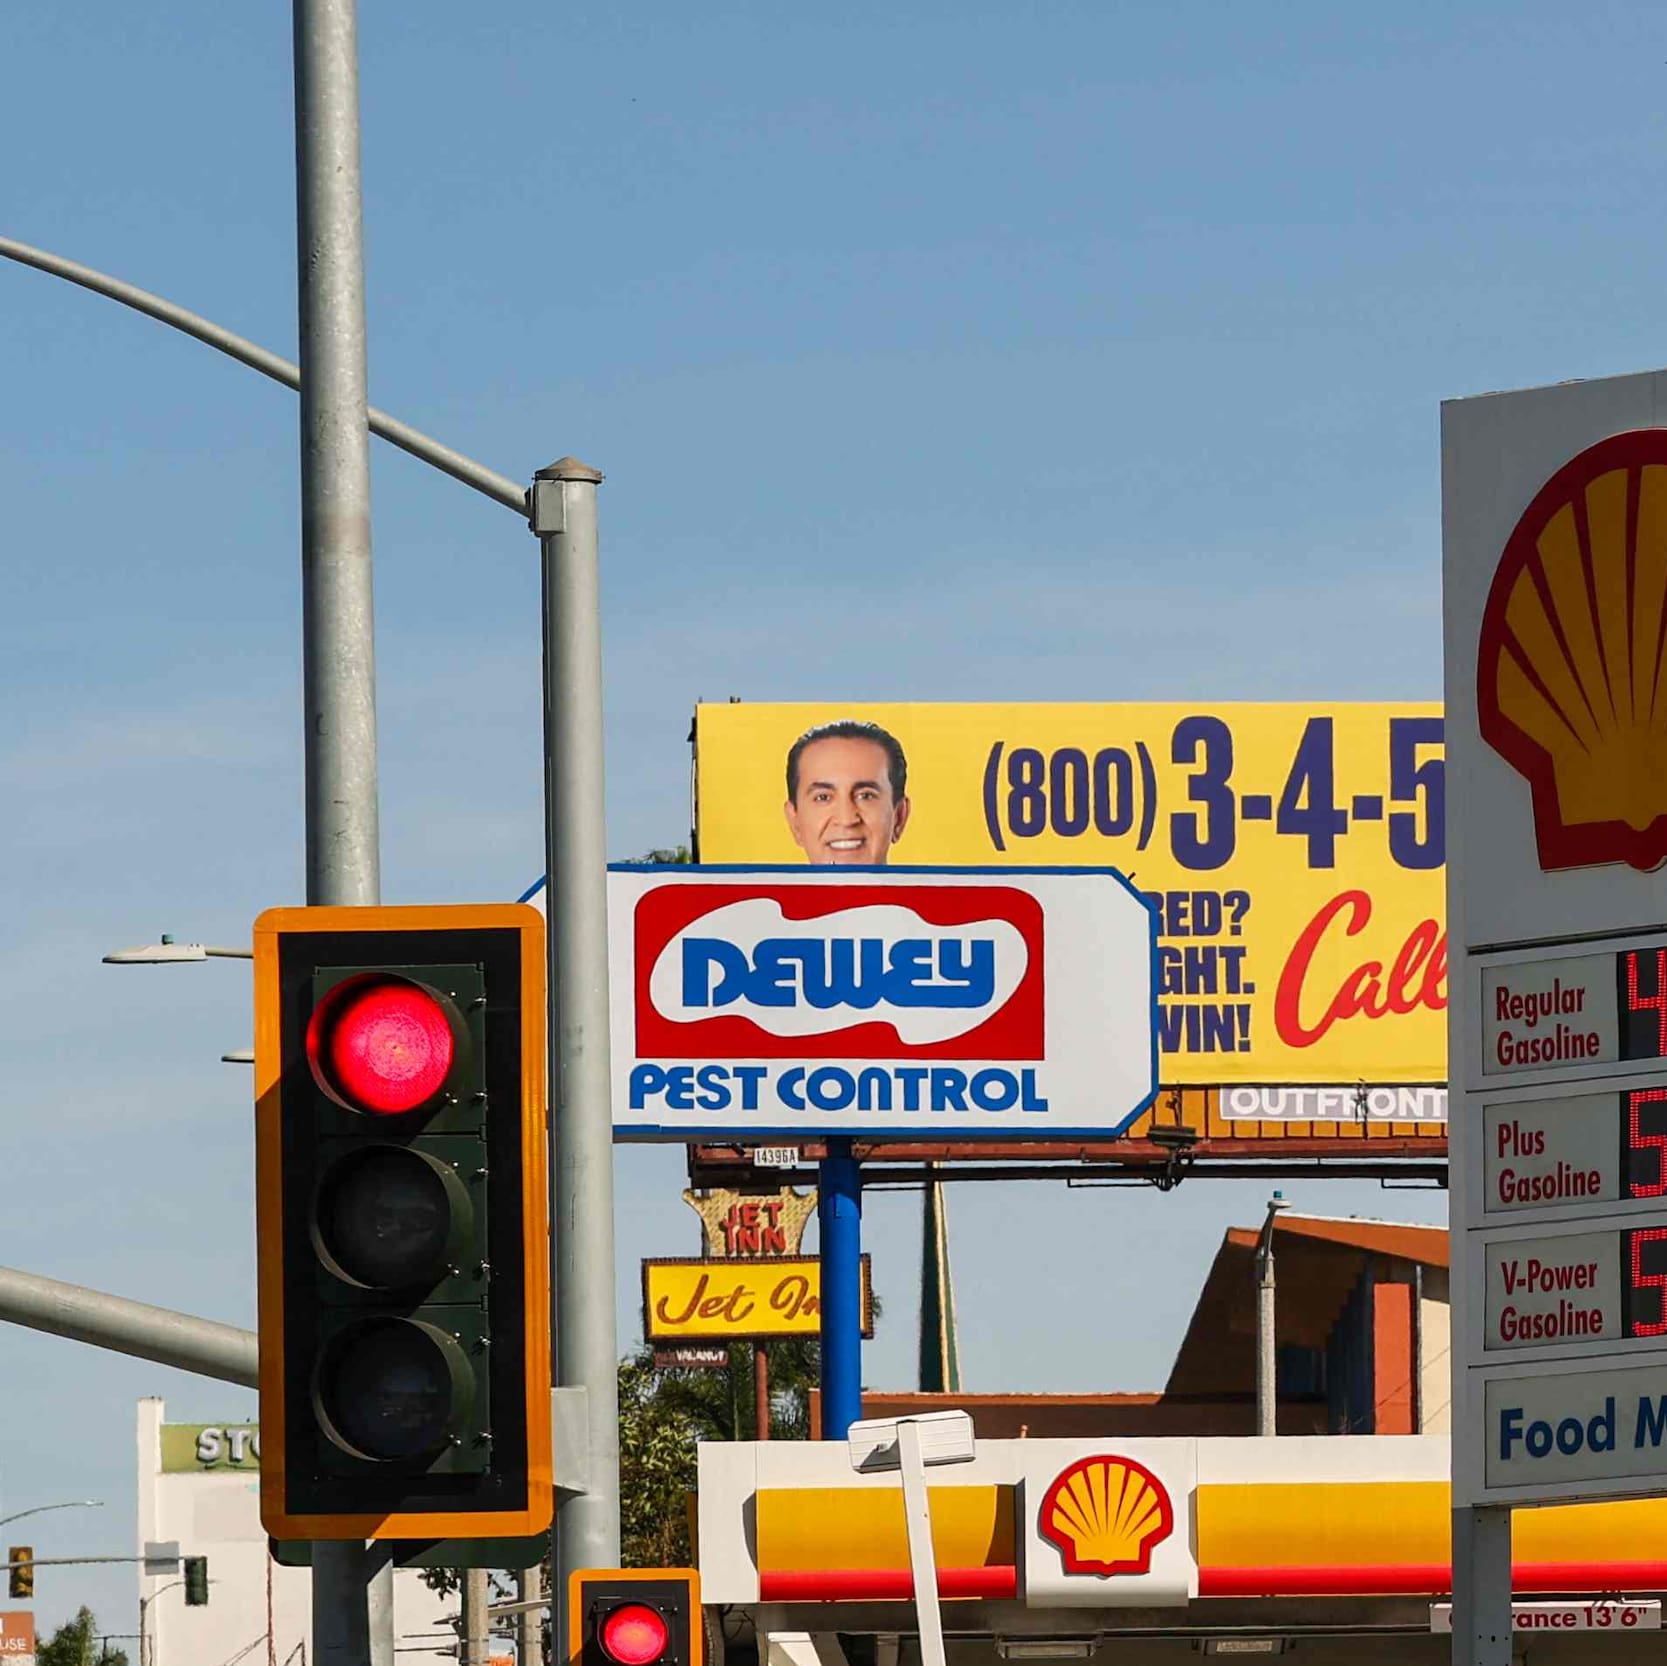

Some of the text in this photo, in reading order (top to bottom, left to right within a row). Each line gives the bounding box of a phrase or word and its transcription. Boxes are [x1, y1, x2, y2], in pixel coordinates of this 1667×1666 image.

[983, 741, 1157, 851] (800)
[682, 936, 995, 1010] DEWEY
[1158, 946, 1255, 995] GHT.
[1496, 978, 1585, 1027] Regular
[1497, 1024, 1600, 1066] Gasoline
[630, 1064, 1048, 1112] PEST CONTROL
[1230, 1086, 1446, 1118] OUTFRONT
[756, 1149, 797, 1164] 14396A
[1498, 1121, 1545, 1158] Plus
[1499, 1161, 1601, 1203] Gasoline
[720, 1202, 783, 1229] JET
[725, 1227, 787, 1253] INN
[1501, 1258, 1598, 1296] V-Power
[656, 1273, 821, 1325] Jet In
[1500, 1300, 1603, 1341] Gasoline
[1500, 1396, 1616, 1460] Food
